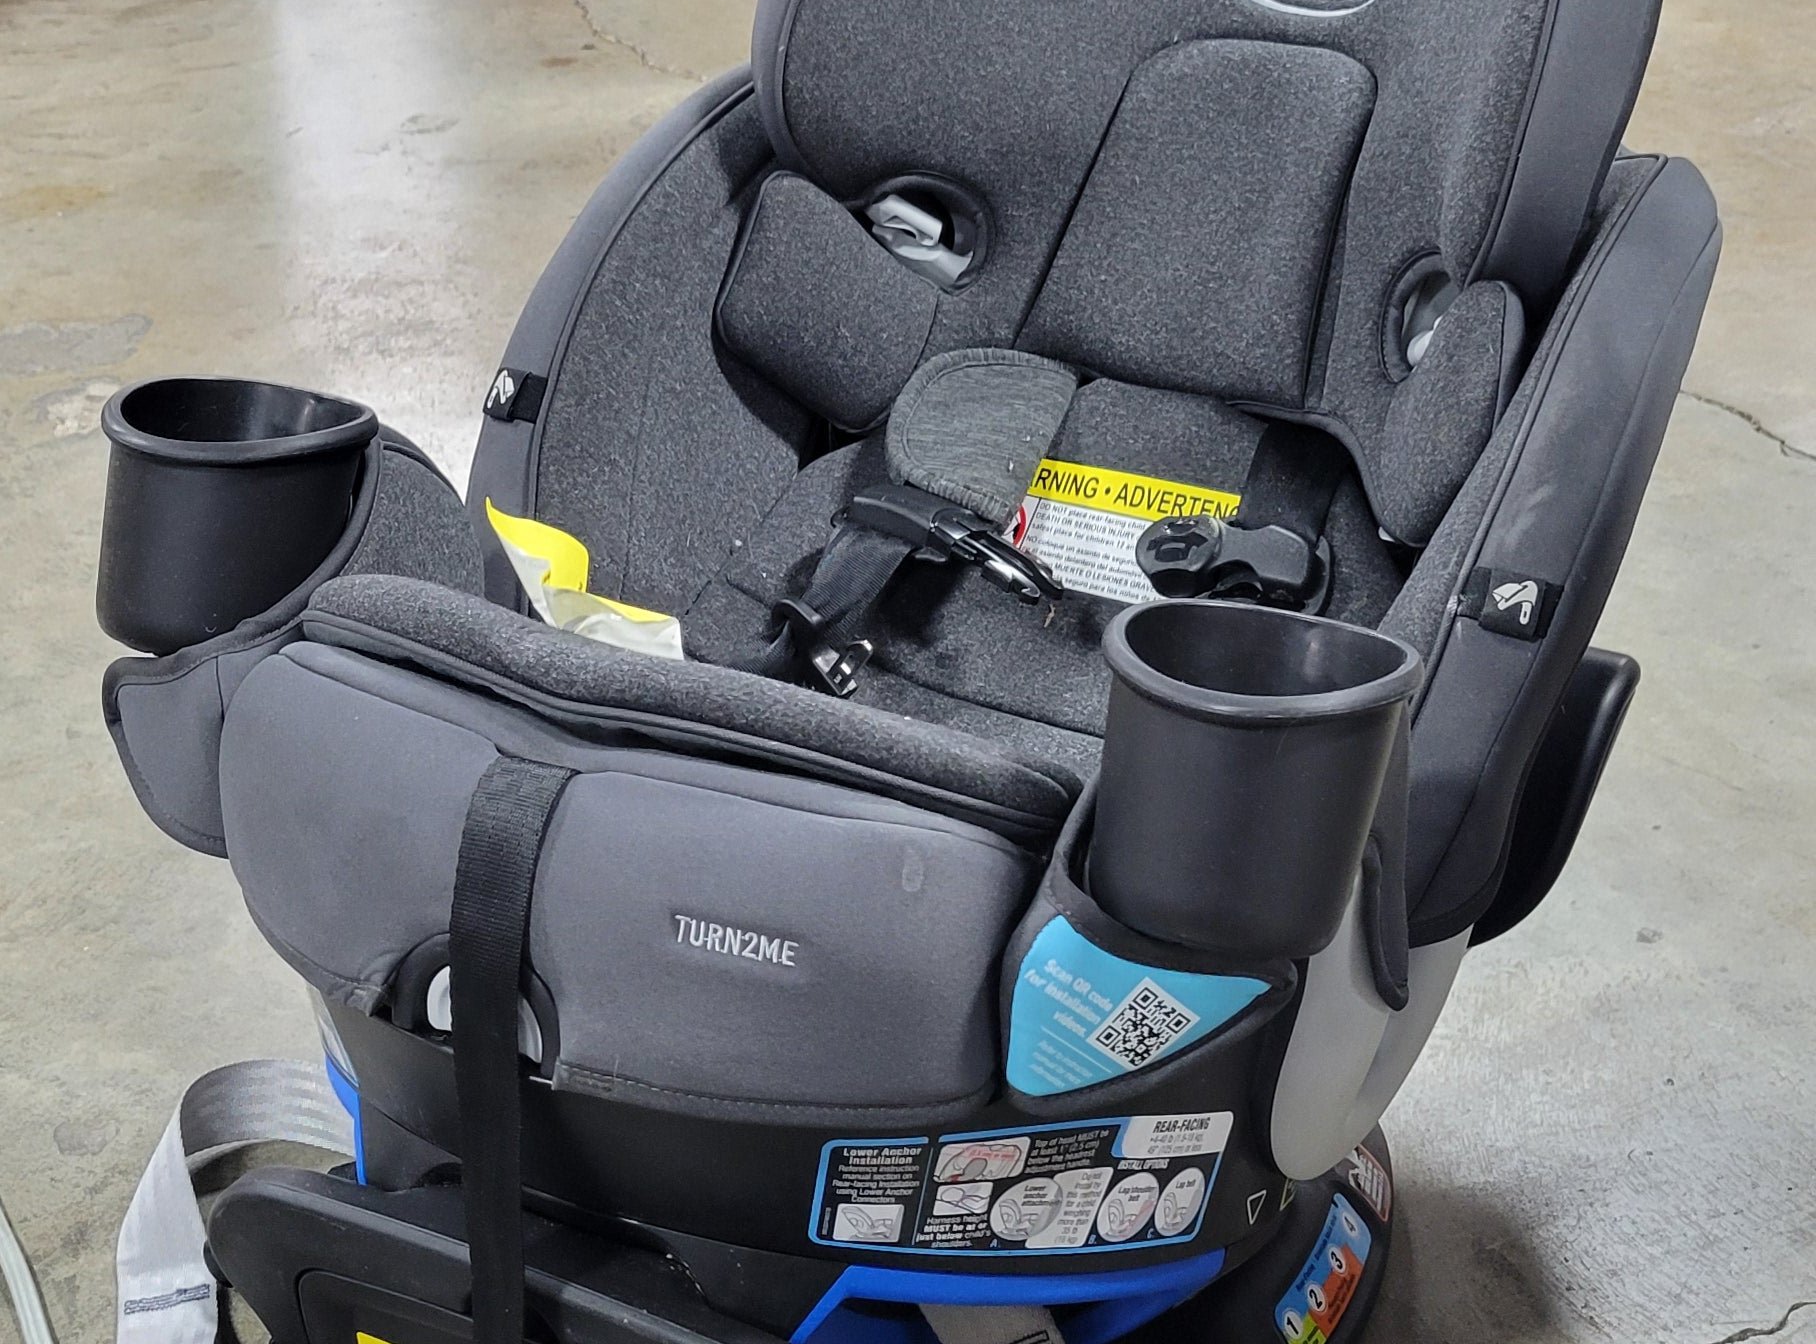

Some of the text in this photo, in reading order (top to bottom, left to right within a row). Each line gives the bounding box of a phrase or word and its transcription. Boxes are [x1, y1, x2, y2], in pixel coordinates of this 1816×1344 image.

[674, 914, 800, 967] TURN2ME
[1153, 1116, 1211, 1134] REAR-FACING
[843, 1146, 922, 1156] Lower Anchor
[848, 1155, 913, 1165] Installation
[923, 1221, 989, 1233] MUST be at or
[1344, 1215, 1357, 1233] 4
[1330, 1250, 1344, 1271] 3
[1308, 1288, 1324, 1310] 2
[1286, 1315, 1299, 1336] 1
